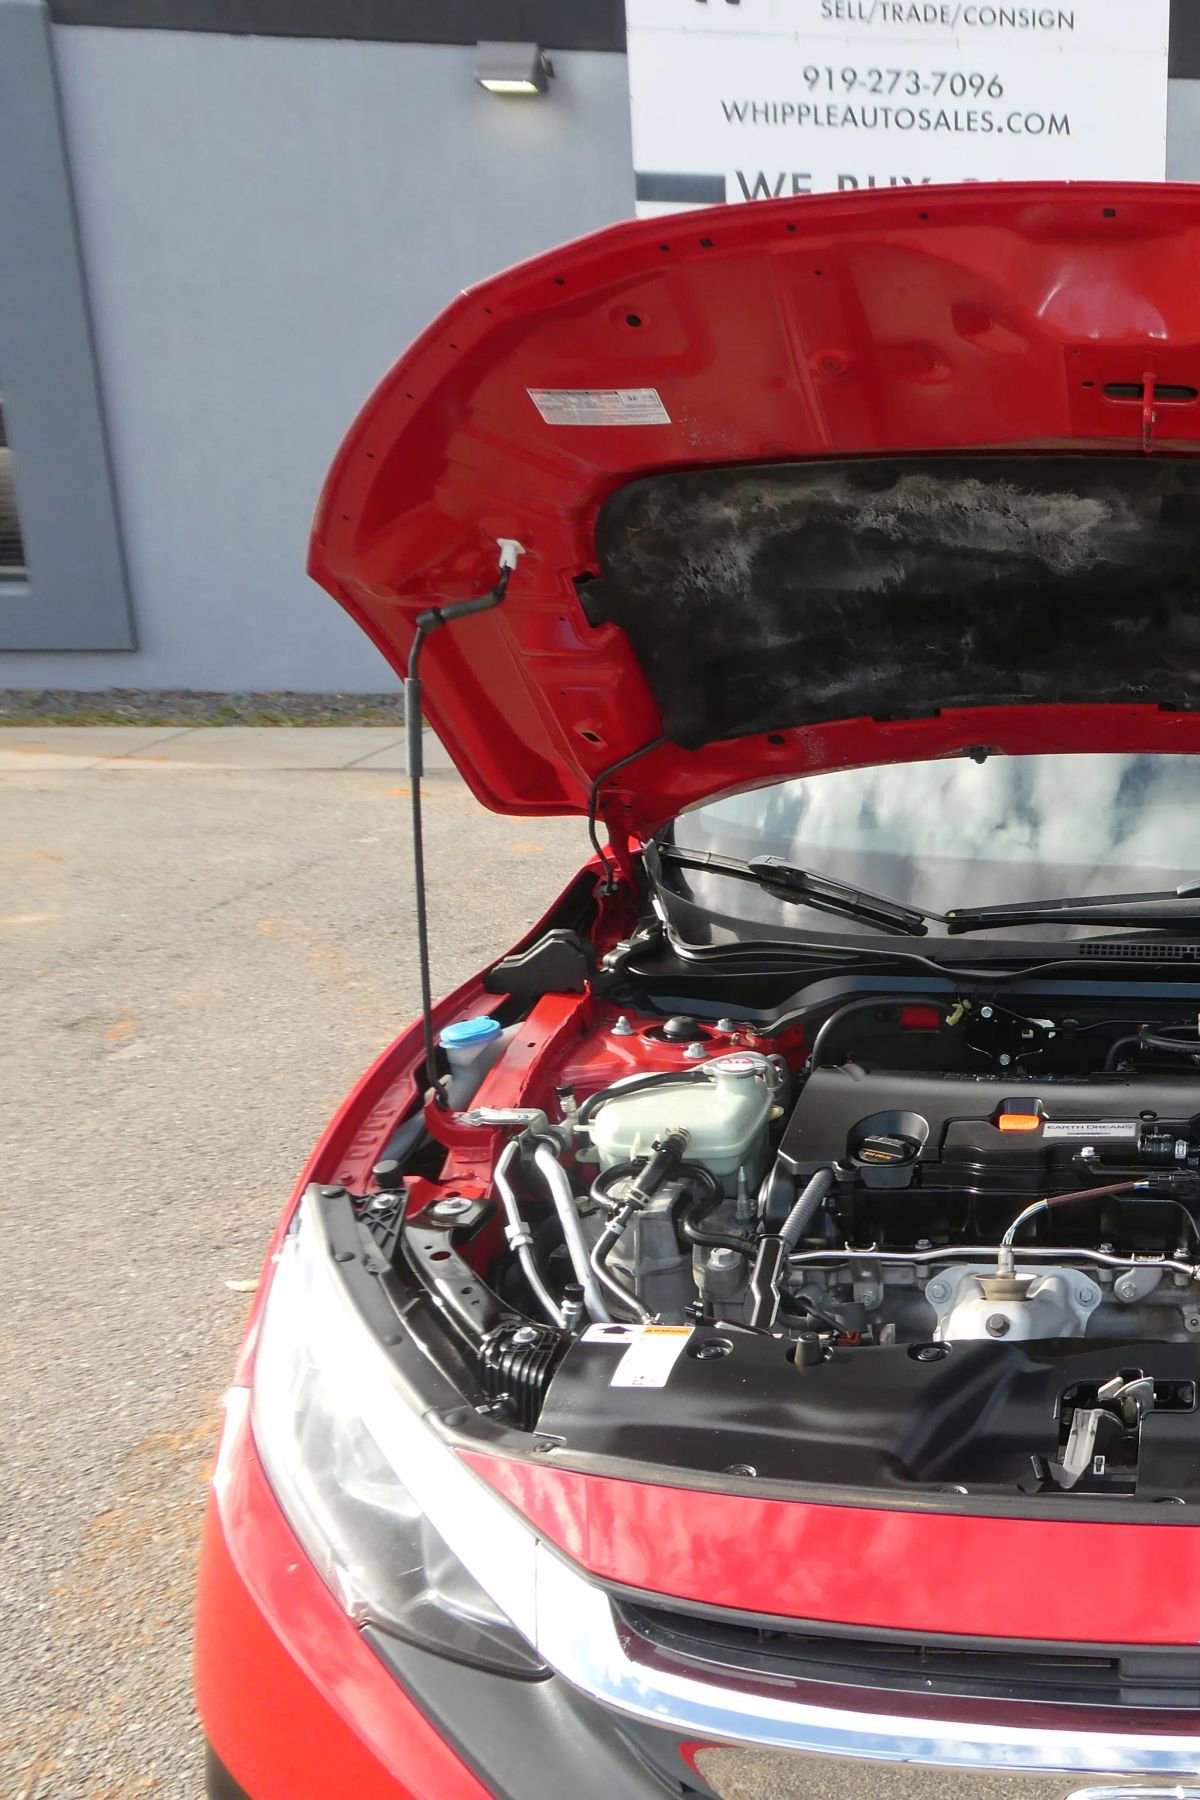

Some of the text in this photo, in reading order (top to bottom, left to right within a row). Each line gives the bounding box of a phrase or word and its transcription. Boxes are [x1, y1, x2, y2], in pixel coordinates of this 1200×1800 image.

[821, 0, 1075, 30] SELL/TRADE/CONSIGN
[802, 66, 1004, 99] 919-273-7096
[721, 101, 1071, 135] WHIPPLEAUTOSALES.COM
